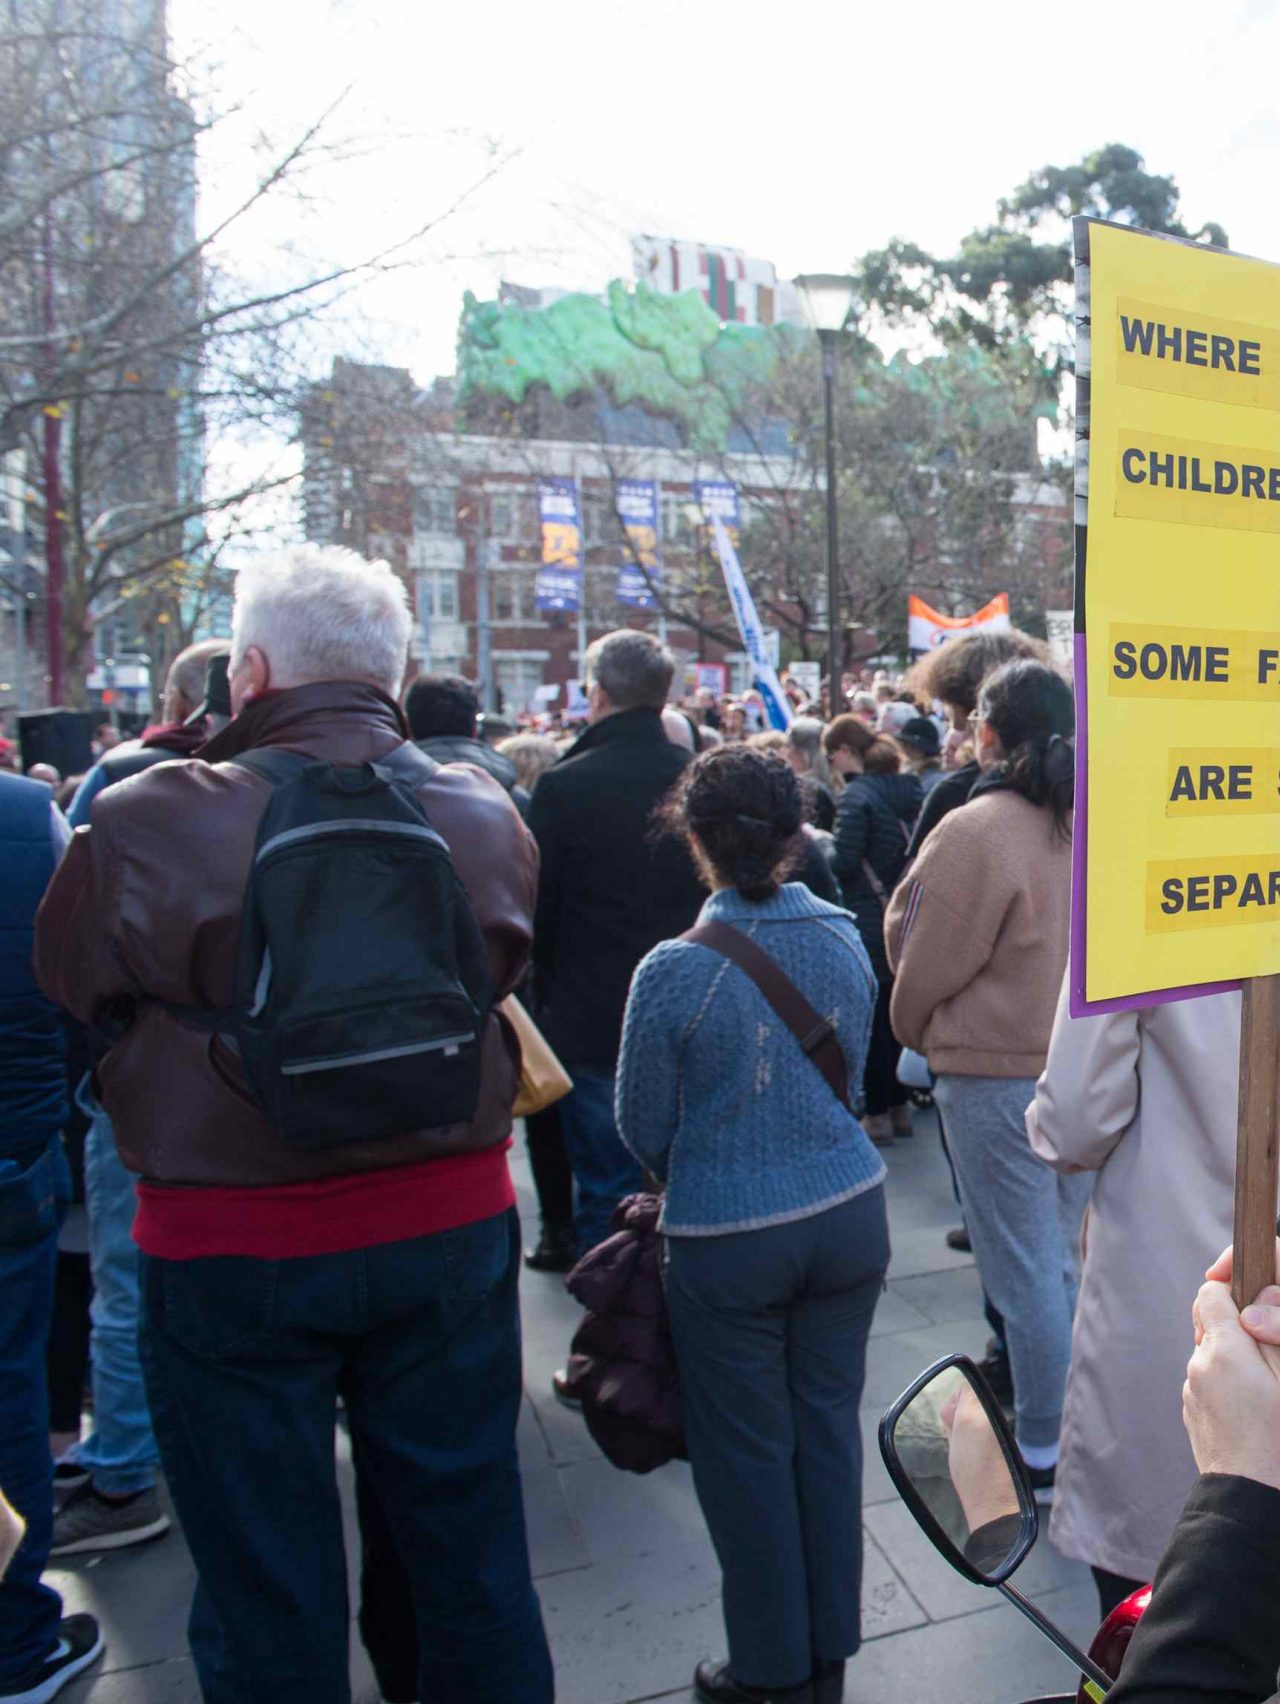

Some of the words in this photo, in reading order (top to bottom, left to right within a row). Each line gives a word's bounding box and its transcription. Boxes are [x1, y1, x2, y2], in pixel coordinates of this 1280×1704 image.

[1120, 316, 1260, 375] WHERE
[1114, 642, 1229, 682] SOME
[1170, 766, 1252, 801] ARE
